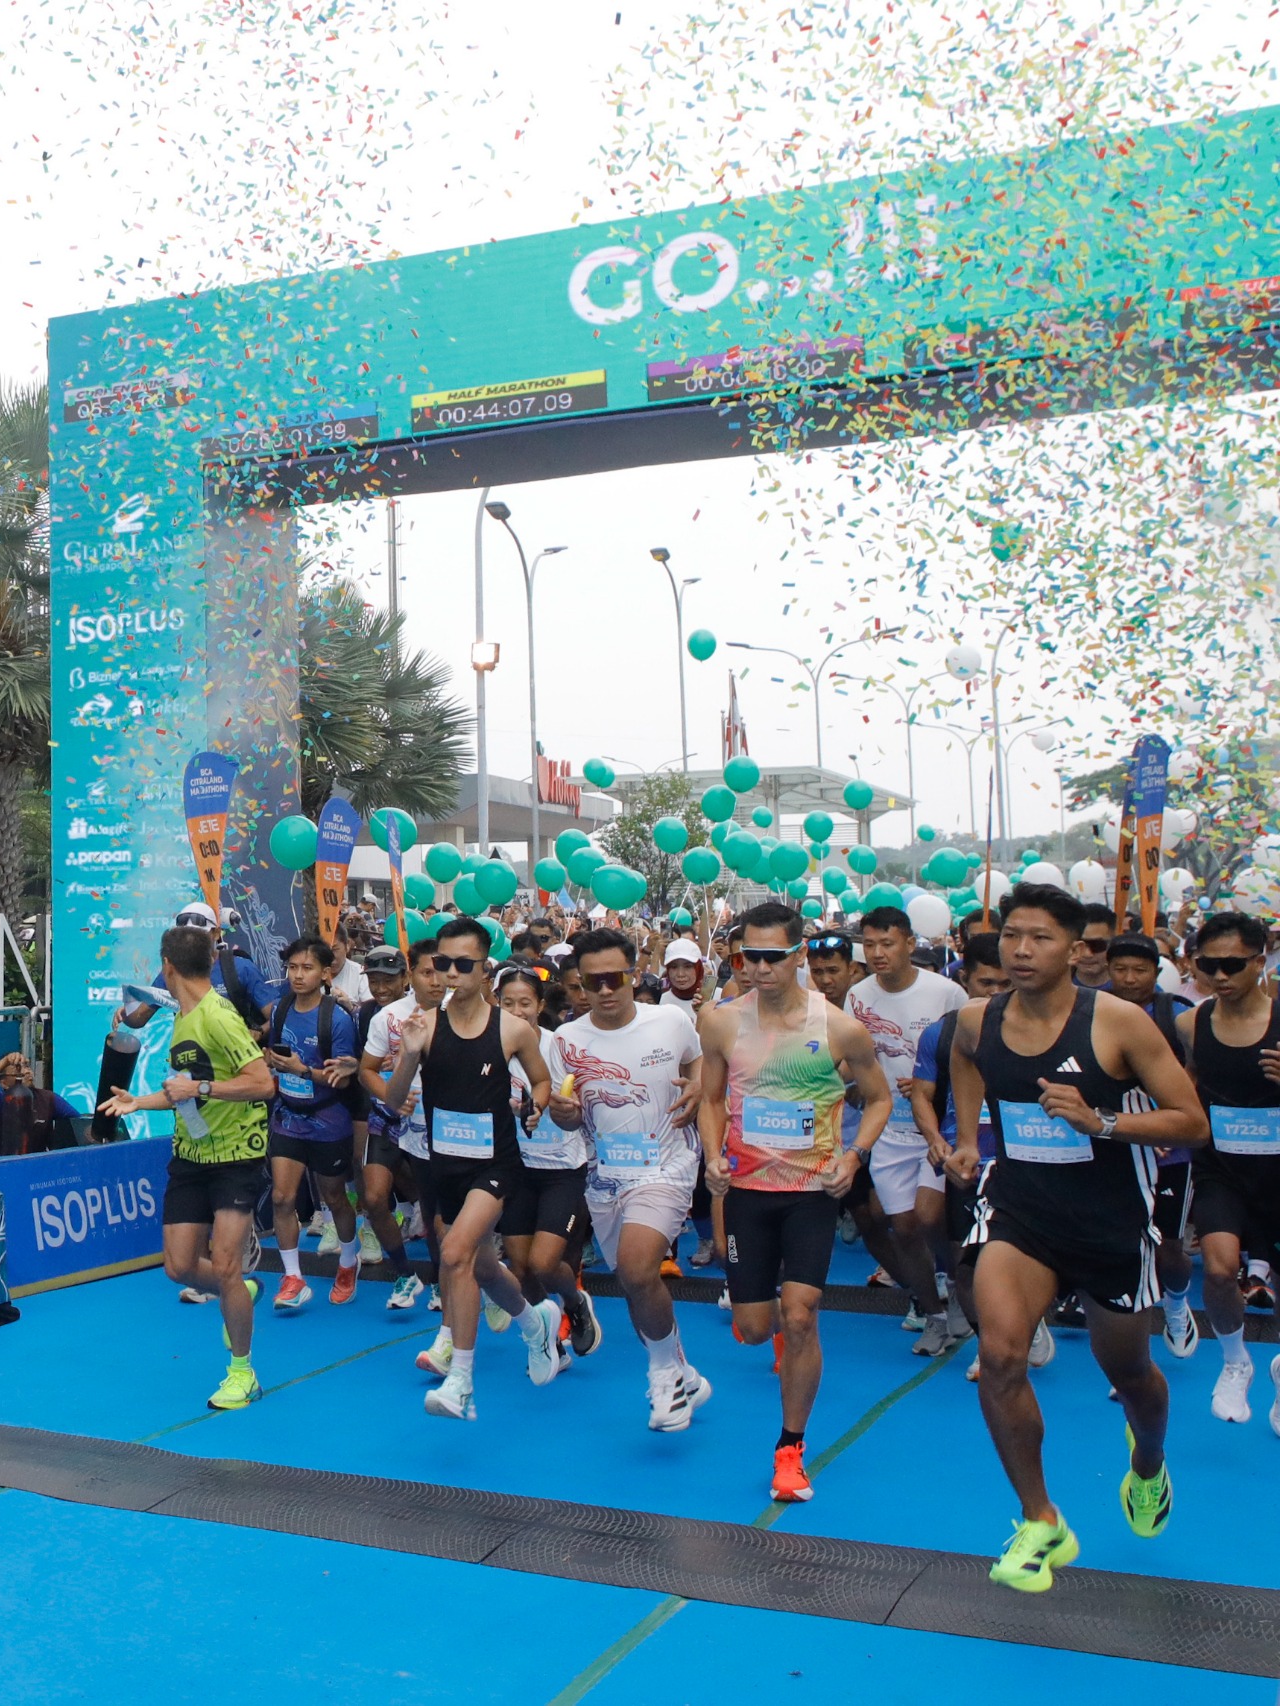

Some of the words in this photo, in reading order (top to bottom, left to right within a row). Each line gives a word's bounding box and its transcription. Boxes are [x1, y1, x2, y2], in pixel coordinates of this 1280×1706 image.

[447, 388, 483, 401] HALF
[485, 376, 567, 395] MARATHON
[69, 607, 185, 645] ISOPLUS
[200, 768, 213, 776] BCA
[190, 776, 223, 787] CITRALAND
[332, 814, 344, 823] BCA
[323, 822, 351, 834] CITRALAND
[78, 850, 132, 865] propan
[641, 1051, 671, 1062] CITRALAND
[755, 1115, 797, 1130] 12091
[804, 1119, 813, 1128] M
[442, 1126, 477, 1140] 17331
[1014, 1123, 1066, 1139] 18154
[1223, 1123, 1270, 1136] 17226
[606, 1149, 643, 1160] 11278
[649, 1149, 659, 1159] M
[31, 1177, 156, 1251] ISOPLUS
